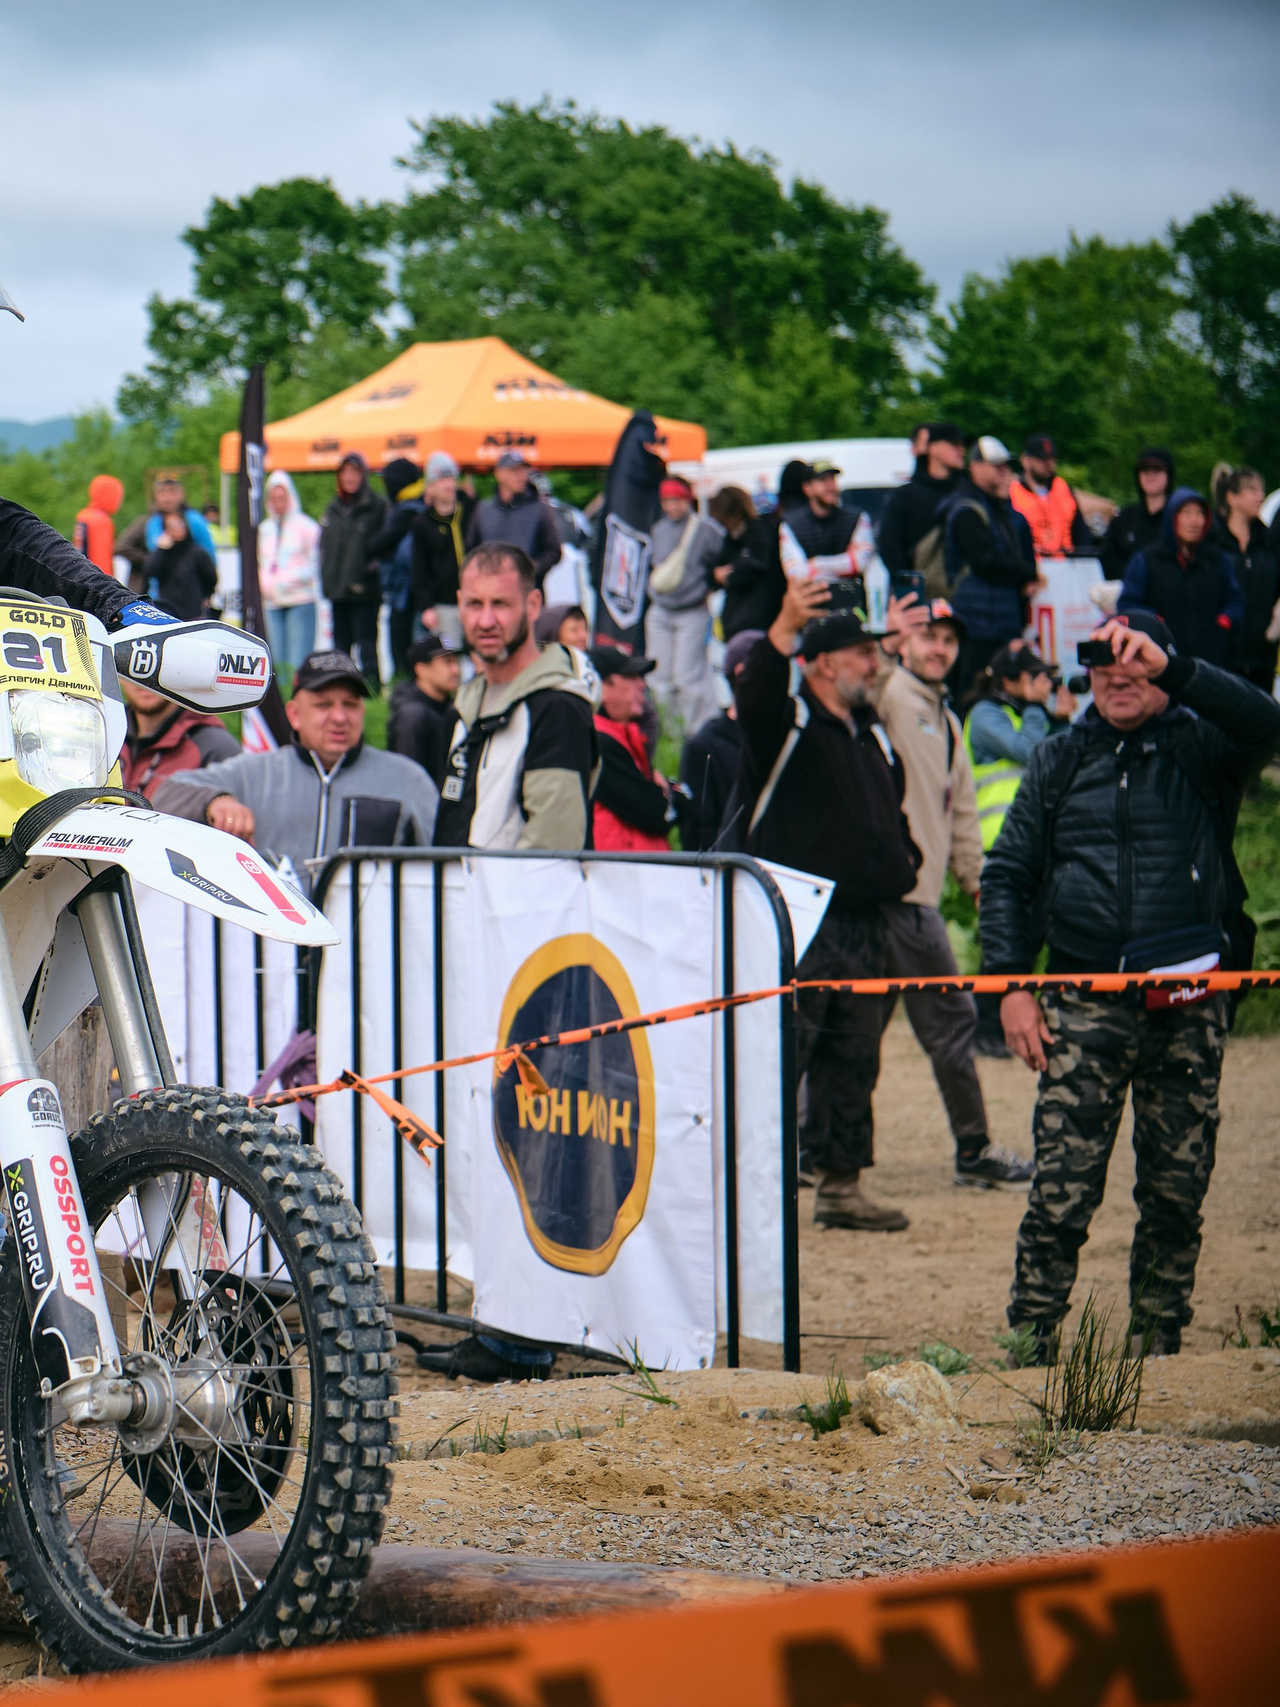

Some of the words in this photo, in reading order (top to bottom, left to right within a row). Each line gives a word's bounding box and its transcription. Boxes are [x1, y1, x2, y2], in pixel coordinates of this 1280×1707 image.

[9, 609, 66, 628] GOLD
[2, 631, 68, 673] 21
[48, 678, 95, 692] Даниил
[46, 832, 133, 848] POLYMERIUM
[49, 1154, 95, 1296] OSSPORT
